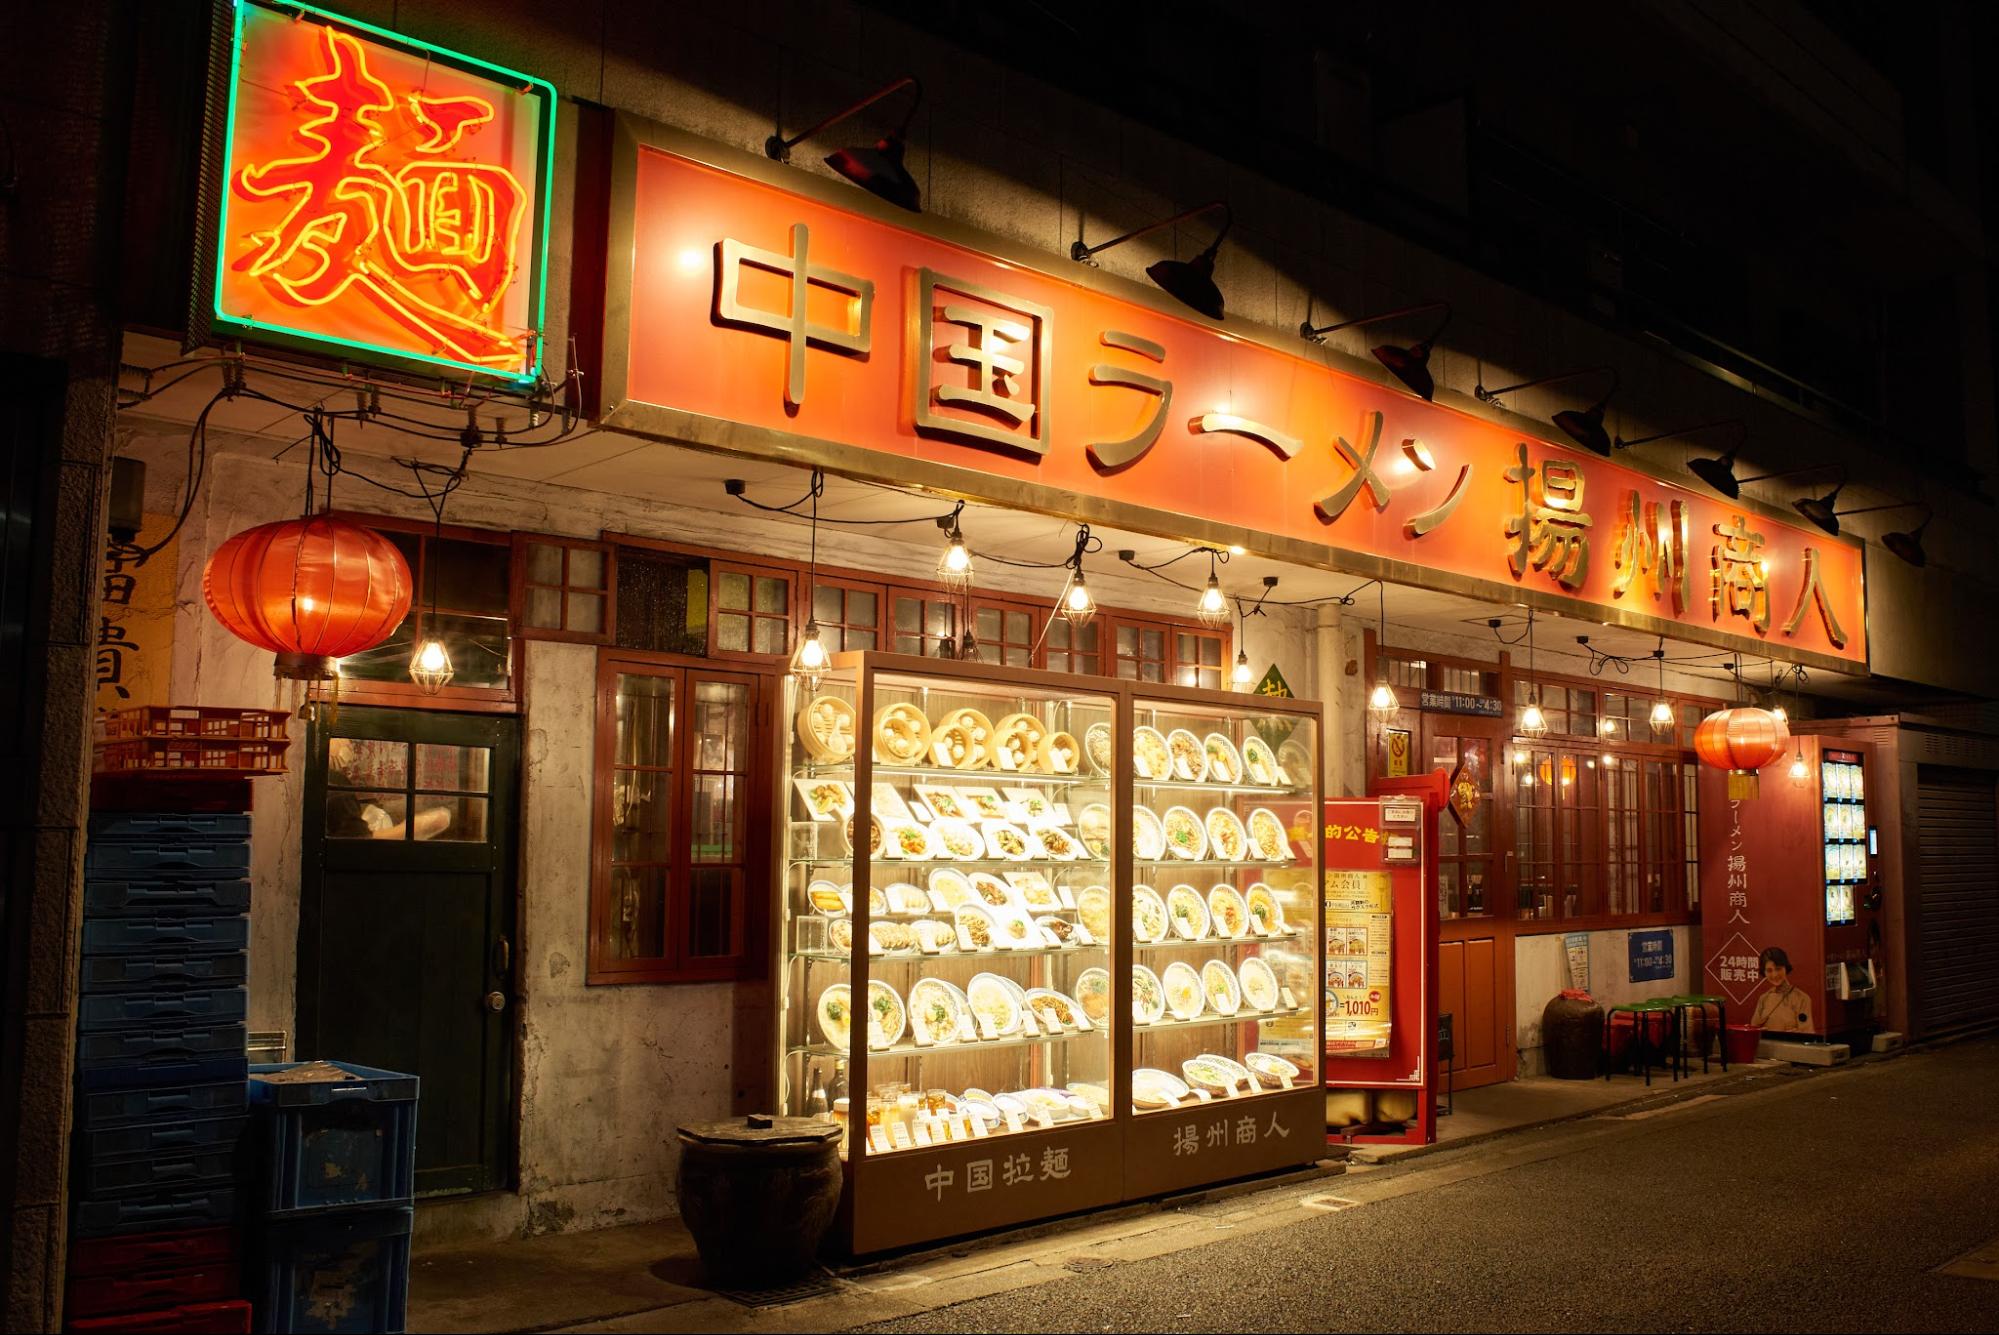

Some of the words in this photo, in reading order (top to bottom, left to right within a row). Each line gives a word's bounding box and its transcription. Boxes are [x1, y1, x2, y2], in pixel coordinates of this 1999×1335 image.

[1720, 955, 1760, 969] 24時間
[1720, 968, 1759, 983] 販売中
[1172, 1111, 1291, 1157] 揚州商人
